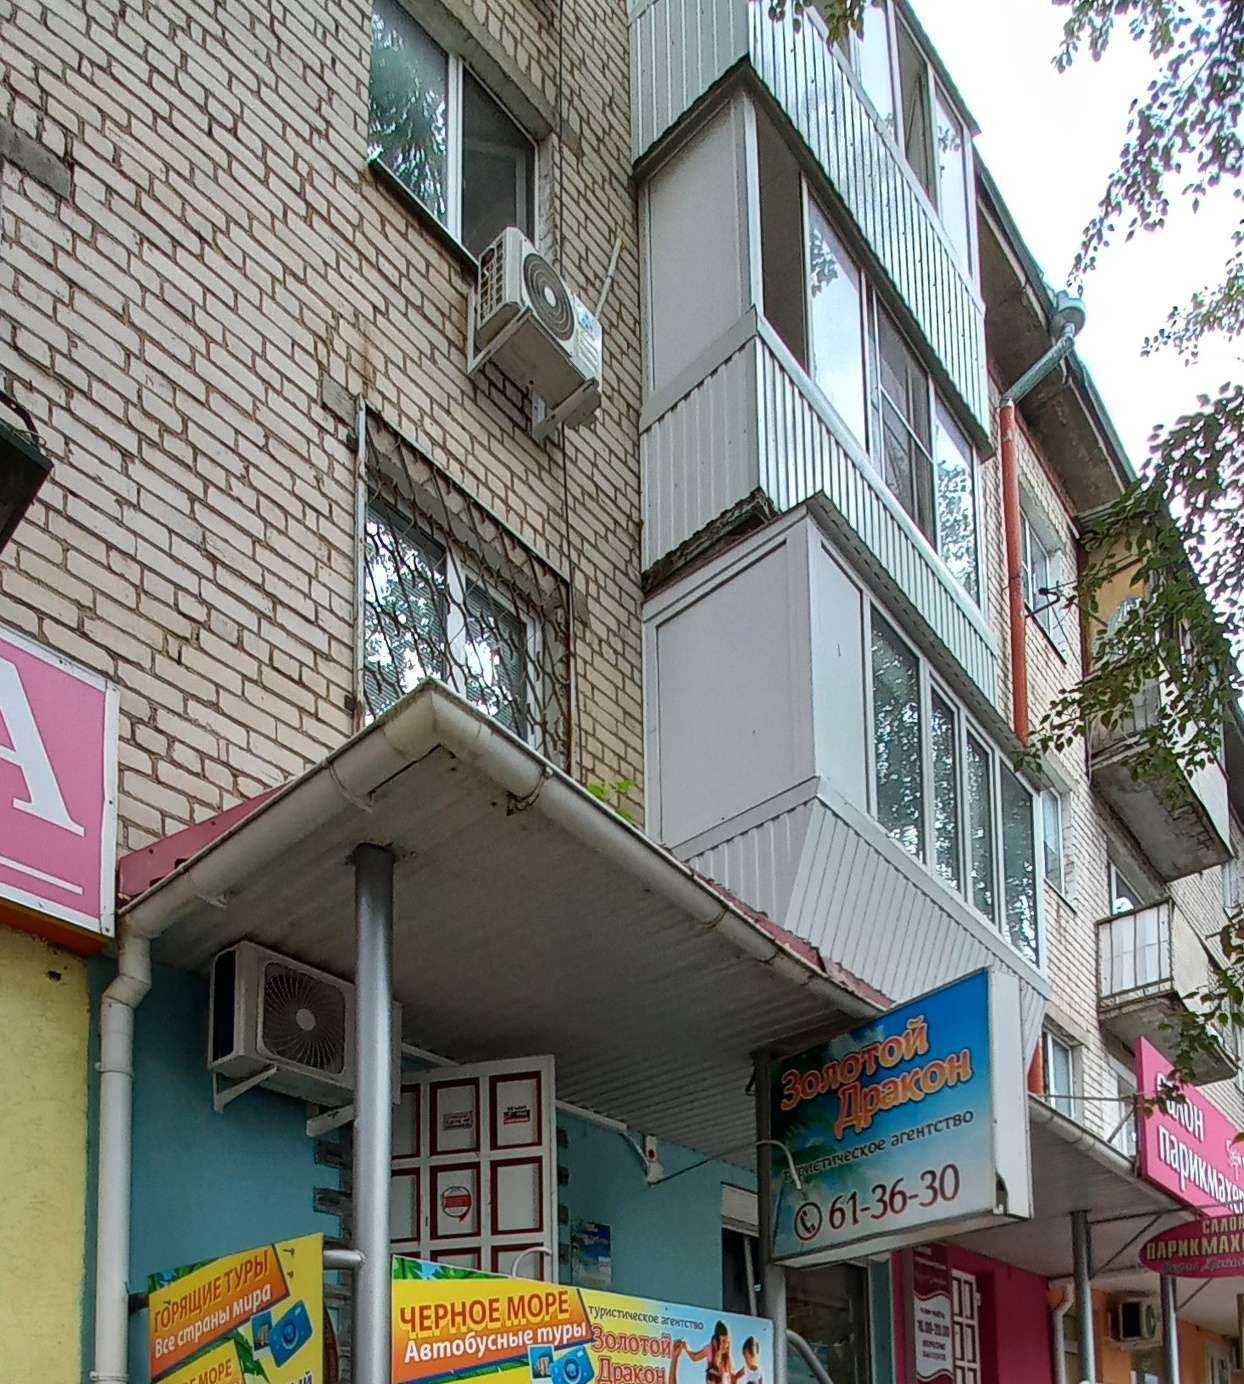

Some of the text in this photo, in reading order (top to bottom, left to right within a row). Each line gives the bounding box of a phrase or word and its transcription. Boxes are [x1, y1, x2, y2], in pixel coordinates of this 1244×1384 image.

[781, 1015, 929, 1111] Золотой
[833, 1049, 972, 1140] Дракон
[891, 1110, 973, 1147] агентство
[829, 1163, 960, 1229] 61-36-30
[154, 1250, 269, 1333] ГОРЯЩИЕ ТУРЫ
[400, 1290, 569, 1333] ЧЕРНОЕ МОРЕ
[588, 1304, 704, 1330] туристическое агентство
[155, 1284, 272, 1358] Все страны мира
[404, 1321, 586, 1364] Автобусные туры
[590, 1324, 672, 1358] Золотой
